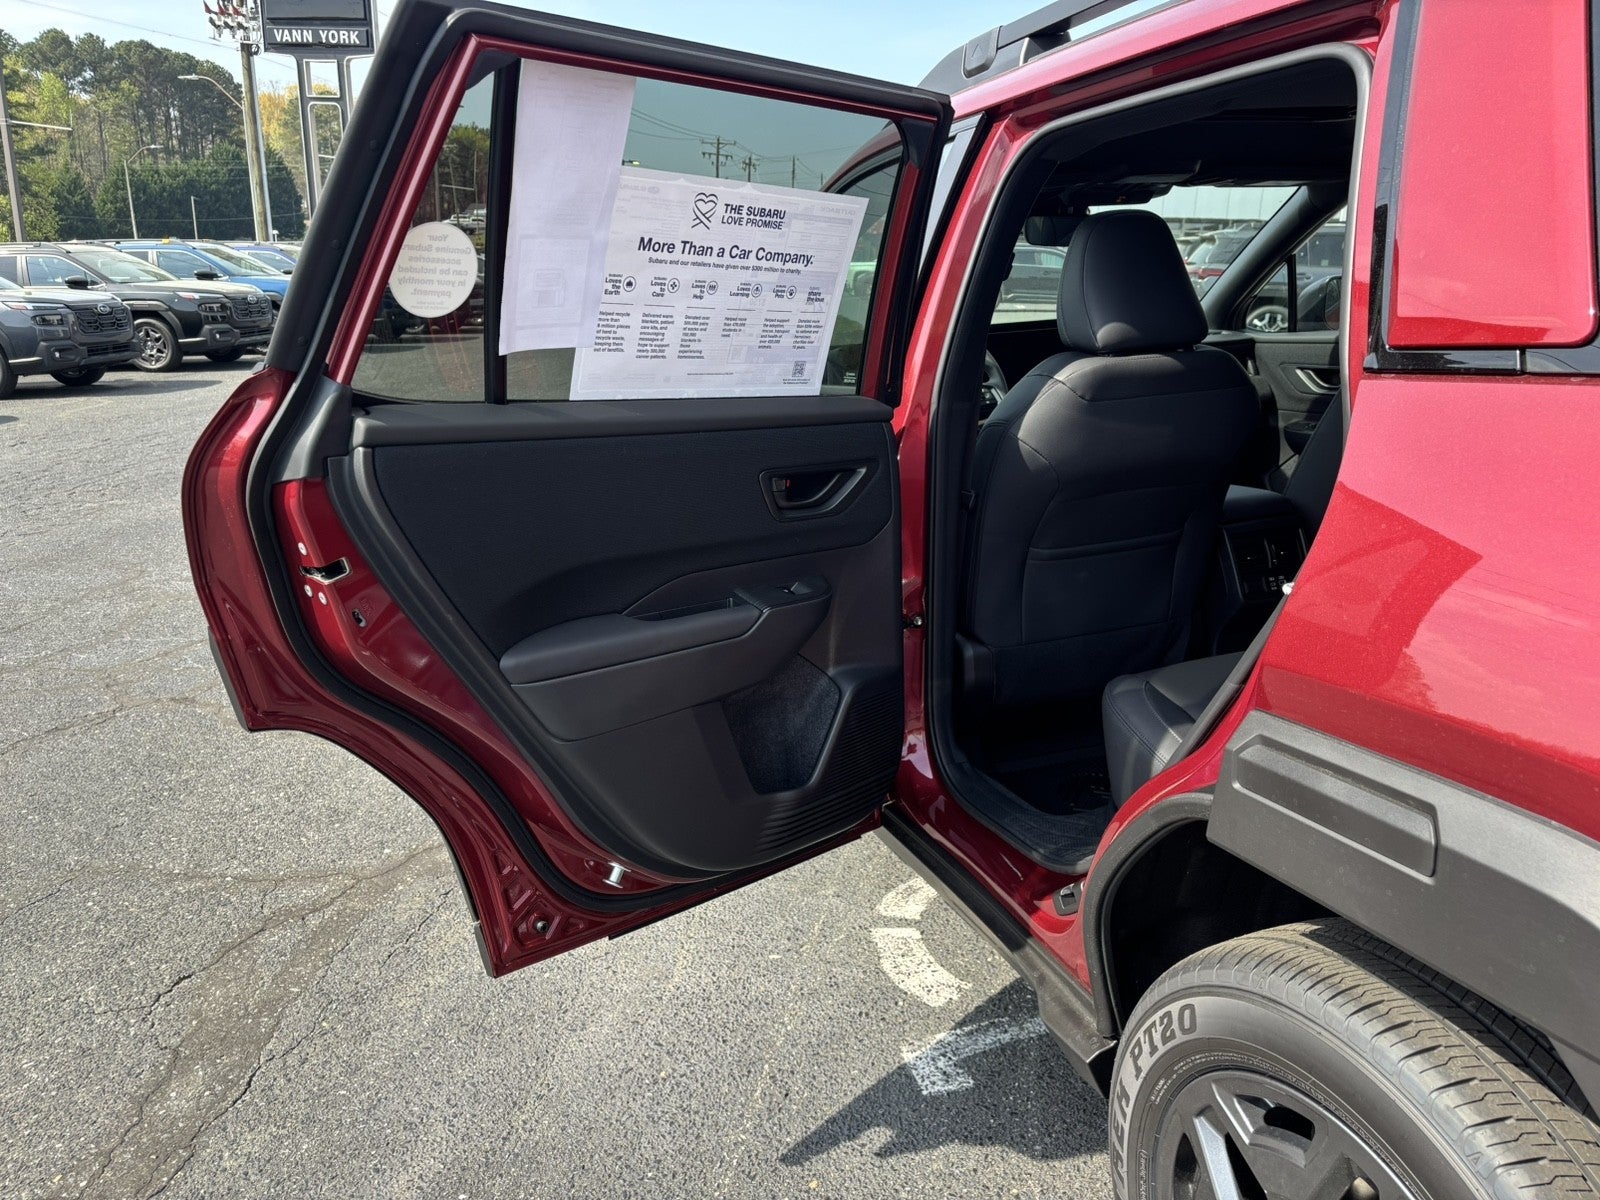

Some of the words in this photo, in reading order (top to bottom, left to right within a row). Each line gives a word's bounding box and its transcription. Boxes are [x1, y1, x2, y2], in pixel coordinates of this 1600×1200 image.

[273, 29, 313, 43] VANN
[319, 30, 360, 44] YORK
[724, 203, 744, 216] THE
[745, 206, 787, 220] SUBARU
[721, 215, 744, 227] LOVE
[745, 218, 784, 231] PROMISE
[637, 236, 676, 254] More
[680, 240, 713, 257] Than
[716, 248, 726, 258] a
[729, 244, 752, 261] Car
[755, 247, 814, 267] Company.
[648, 256, 668, 265] Subaru
[690, 259, 711, 268] retailers
[725, 262, 739, 271] given
[751, 264, 764, 272] $300
[763, 265, 779, 273] million
[785, 267, 802, 275] charity.
[729, 291, 750, 299] Learning
[1130, 1003, 1198, 1082] PT20
